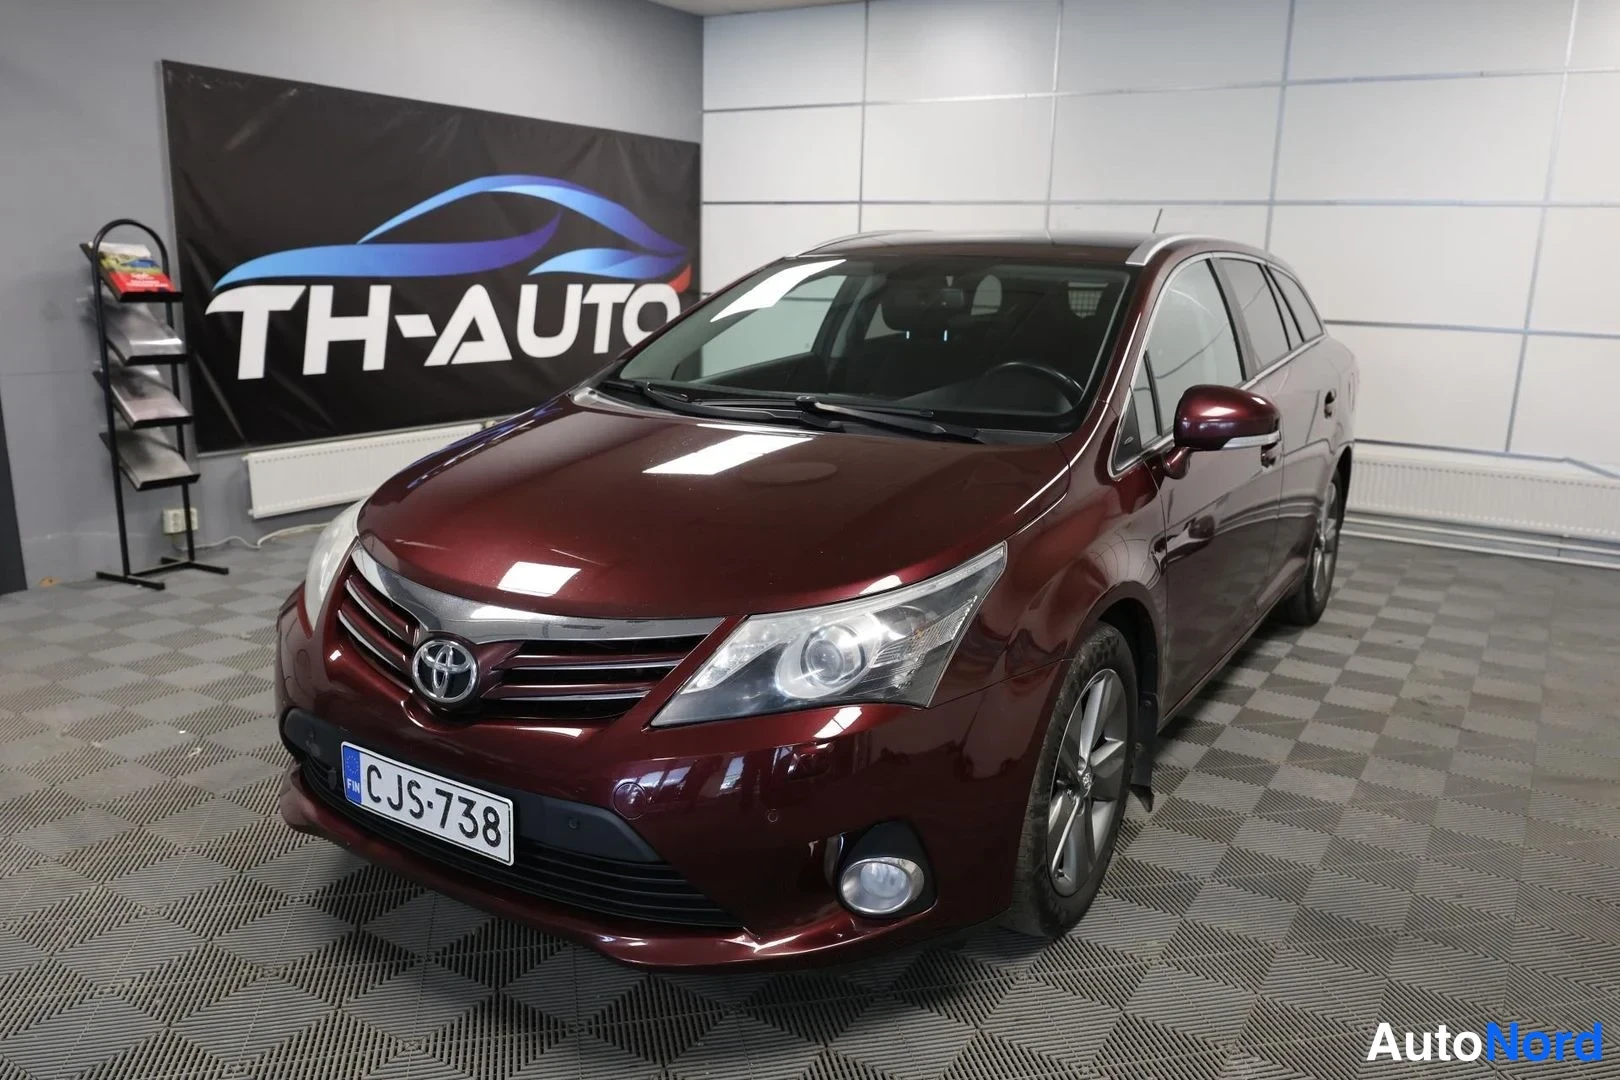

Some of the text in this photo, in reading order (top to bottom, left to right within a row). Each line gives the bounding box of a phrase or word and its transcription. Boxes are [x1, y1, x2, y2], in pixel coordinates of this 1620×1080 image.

[205, 284, 681, 380] TH-AUTO
[347, 778, 361, 794] FIN
[366, 764, 502, 848] CJS-738
